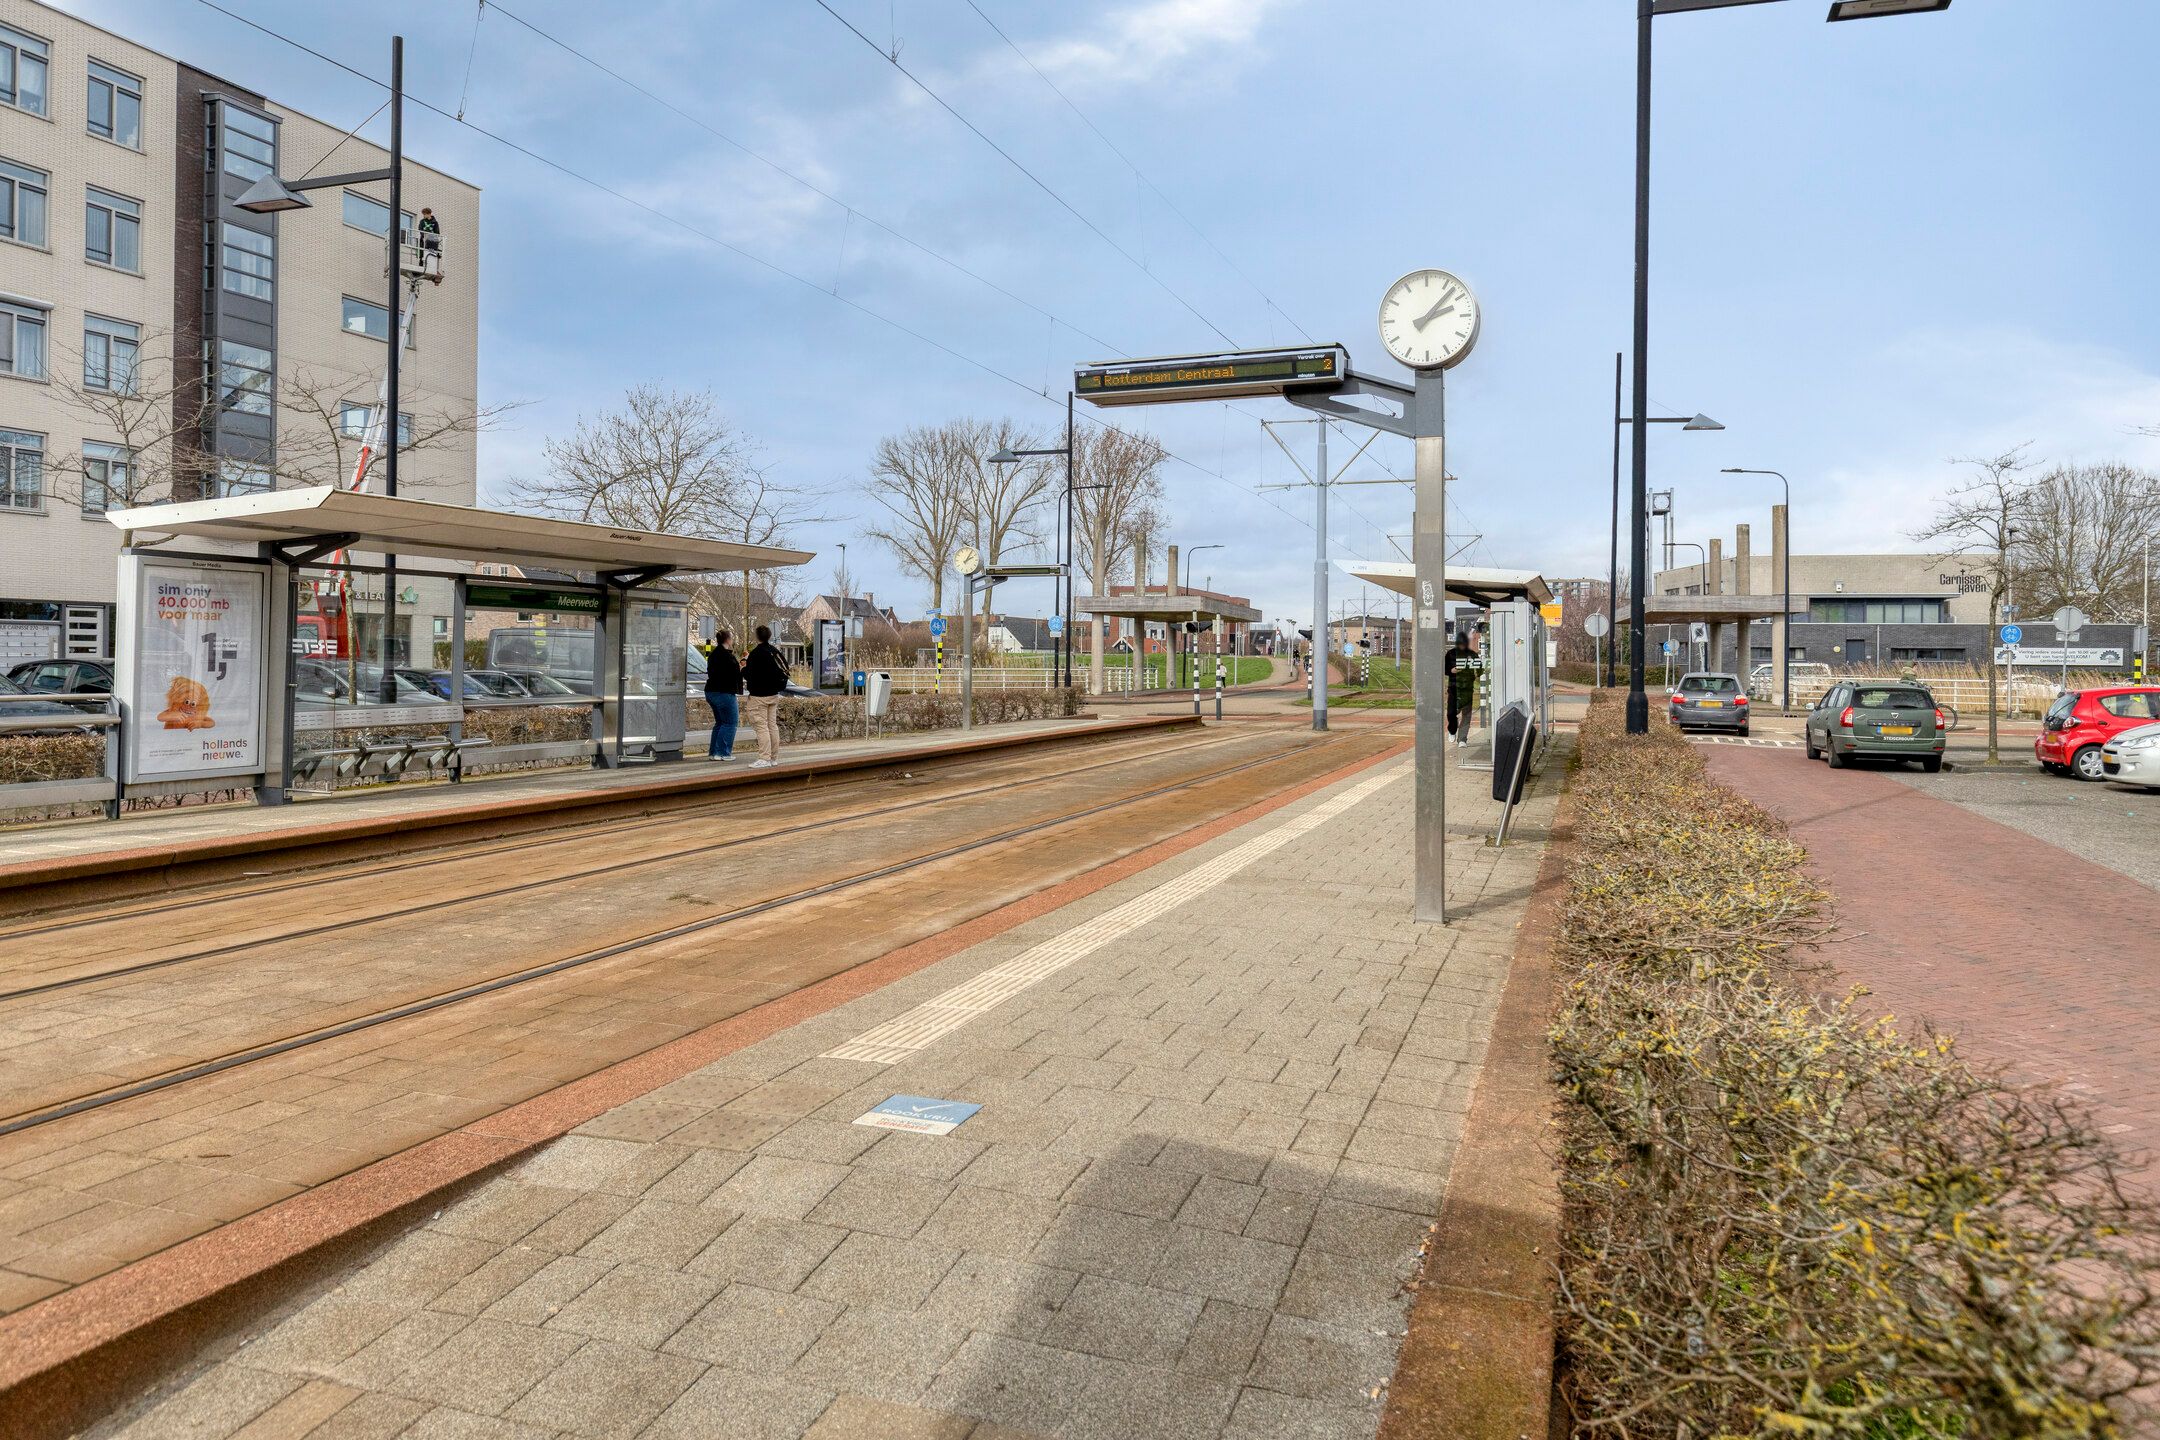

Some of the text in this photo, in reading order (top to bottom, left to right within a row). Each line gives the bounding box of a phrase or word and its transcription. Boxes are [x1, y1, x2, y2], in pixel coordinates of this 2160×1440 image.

[1323, 358, 1332, 370] 2
[1104, 372, 1171, 387] Rotterdam
[1177, 366, 1235, 380] Centraal
[1940, 573, 1981, 586] Carnisse
[158, 583, 212, 599] sim only
[1958, 584, 1987, 595] Haven
[158, 596, 230, 610] 40.000 mb
[557, 595, 599, 608] Meerwede
[158, 610, 223, 621] voor maar
[203, 739, 248, 750] hollands
